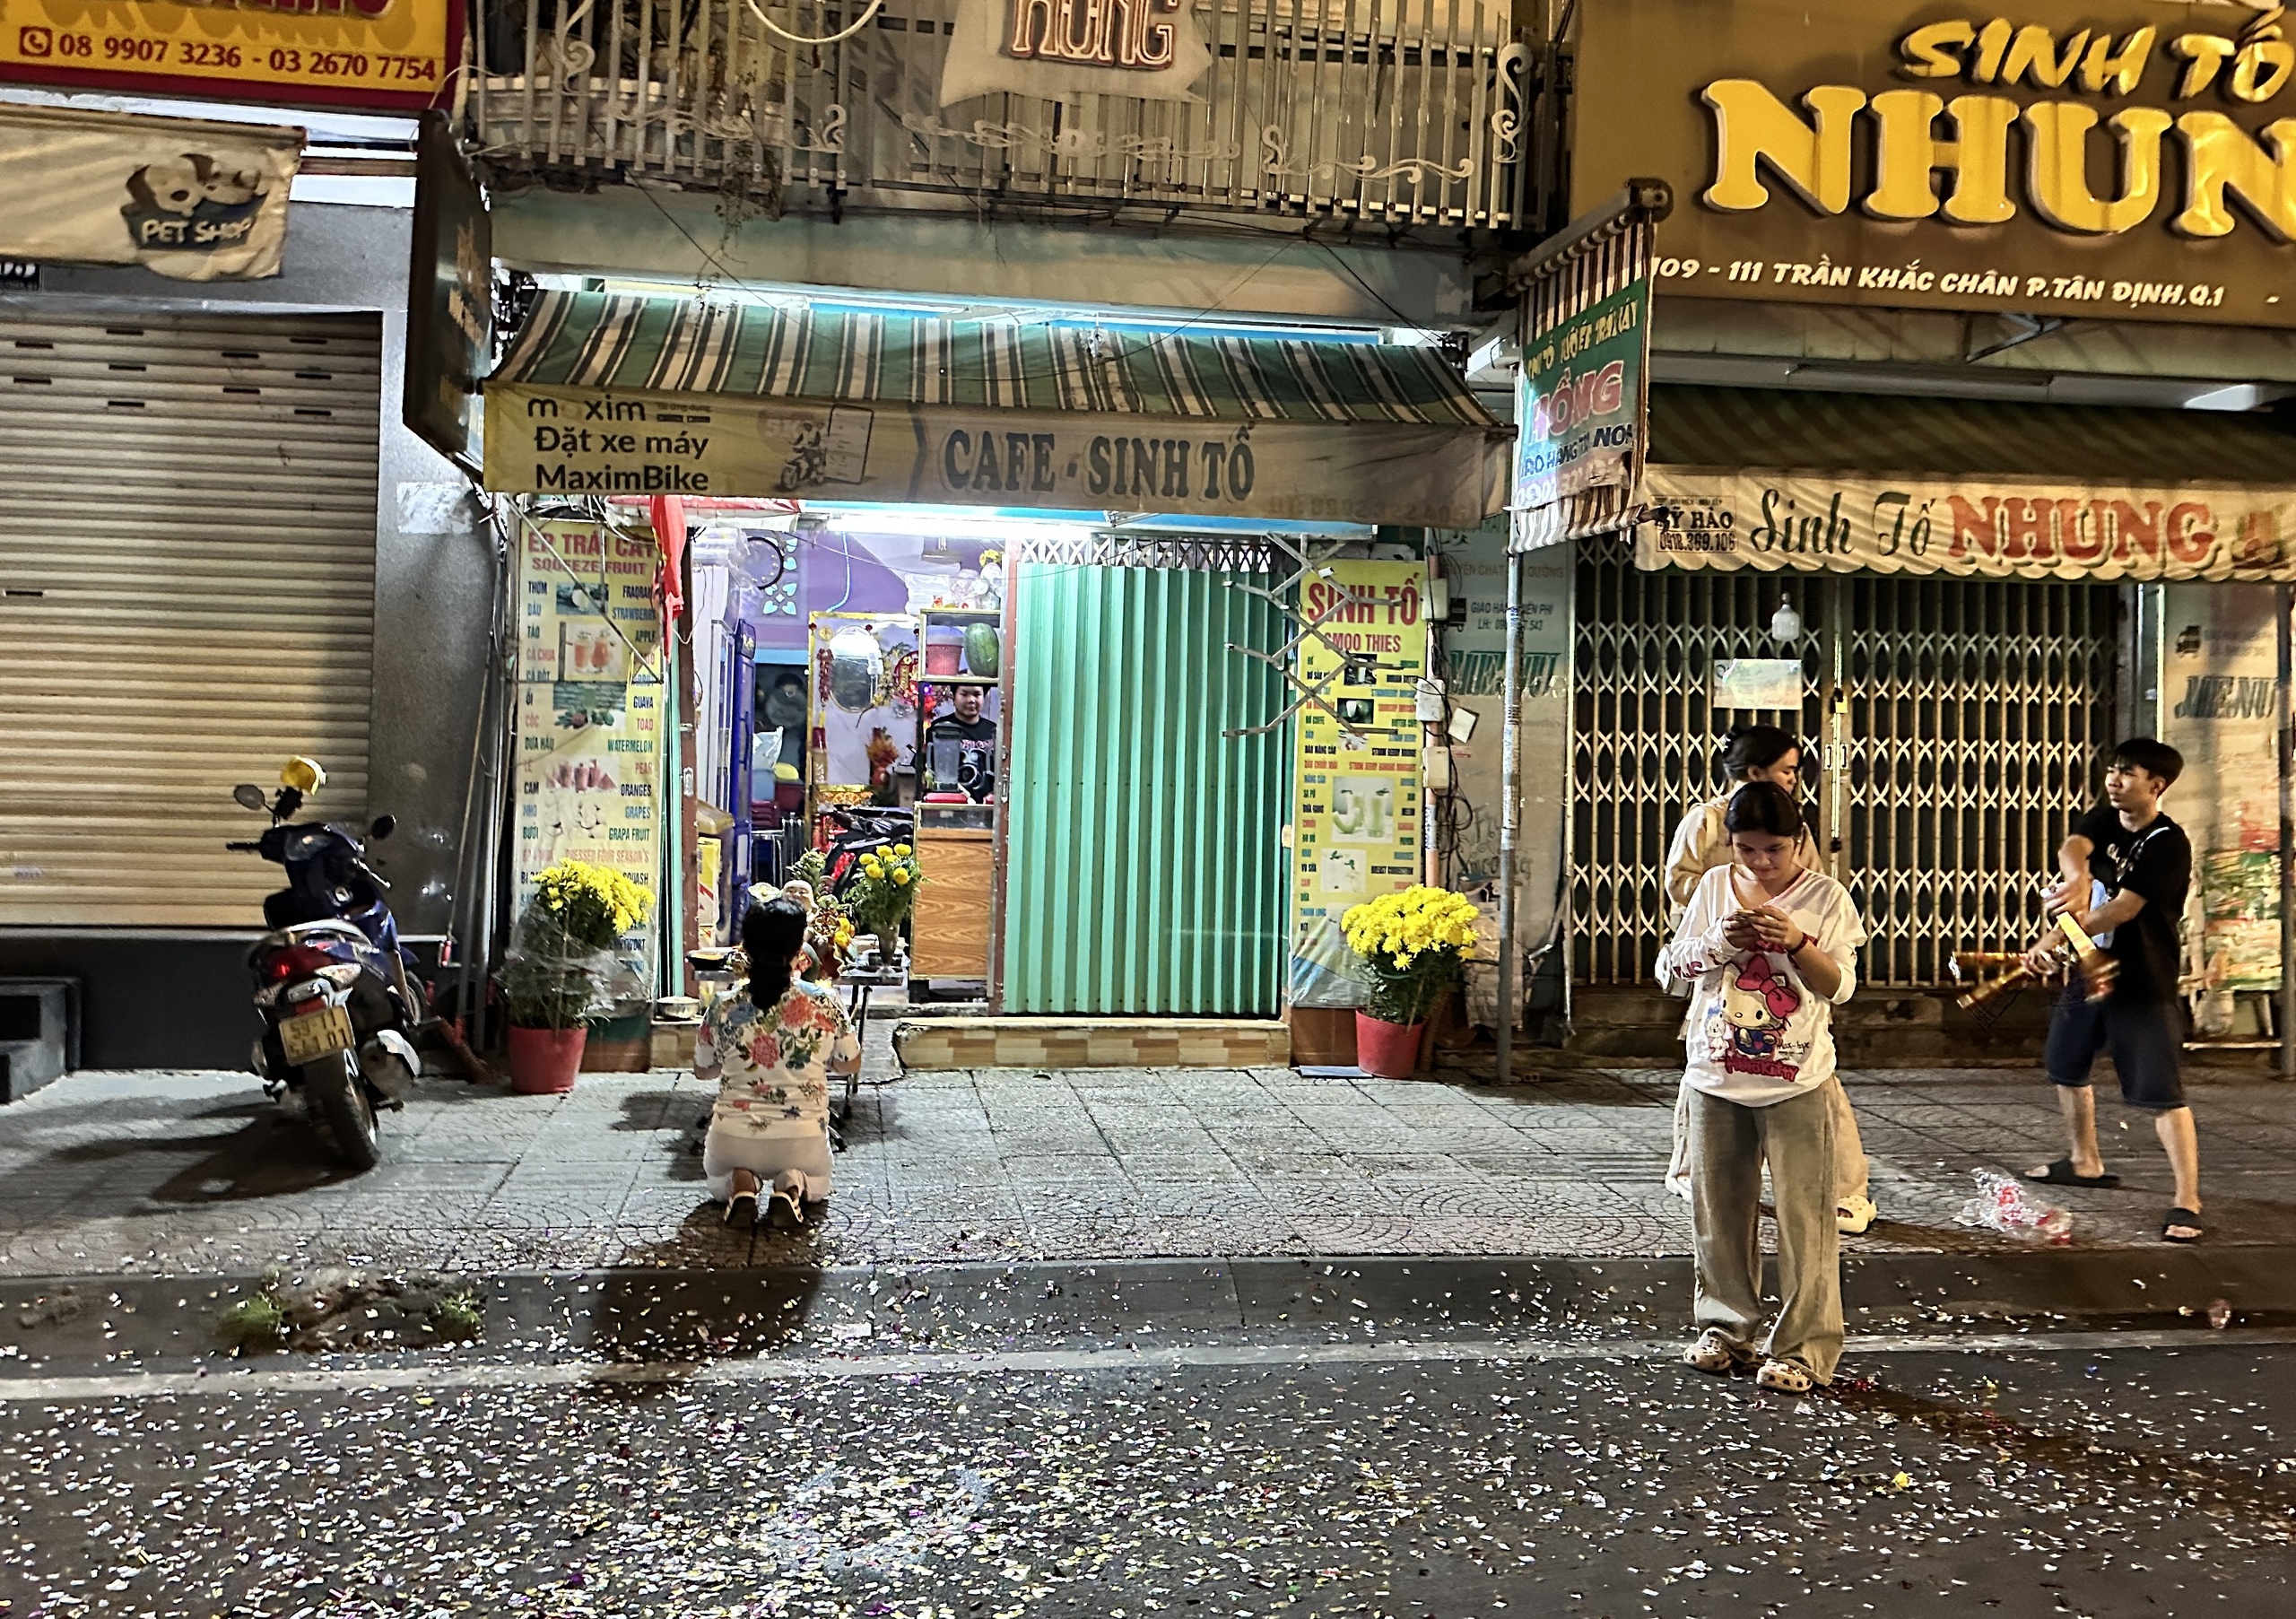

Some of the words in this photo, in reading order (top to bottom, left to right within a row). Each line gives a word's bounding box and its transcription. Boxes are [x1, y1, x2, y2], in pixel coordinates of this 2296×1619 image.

[59, 34, 92, 56] 08
[104, 37, 169, 63] 9907
[179, 43, 242, 68] 3236
[269, 48, 301, 72] 03
[309, 52, 368, 77] 2670
[377, 57, 437, 82] 7754
[1902, 18, 2156, 95] SINH
[2169, 5, 2294, 102] TỐ
[141, 220, 186, 243] PET
[194, 221, 252, 243] SHOP
[1728, 261, 1761, 281] 111
[1773, 253, 1851, 286] TRẦN
[1860, 261, 1934, 292] KHẮC
[1941, 268, 2016, 296] CHÂN
[2025, 274, 2104, 301] P.TÂN
[535, 426, 590, 459] Đặt
[600, 431, 636, 452] xe
[645, 430, 709, 459] máy
[944, 429, 1057, 493] CAFE
[1084, 434, 1191, 499] SINH
[536, 463, 709, 492] MaximBike
[1690, 506, 1734, 529] HẢO
[1750, 489, 1853, 555] Sinh
[1872, 492, 1935, 557] Tố
[1946, 493, 2220, 566] NHUNG
[1308, 582, 1376, 624] SINH
[1385, 572, 1420, 626] TỐ
[1366, 635, 1402, 653] THIES
[633, 695, 654, 709] GUAVA
[607, 739, 653, 753] WATERMELON
[621, 784, 652, 797] ORANGES
[625, 805, 651, 820] GRAPES
[631, 829, 650, 841] FRUIT
